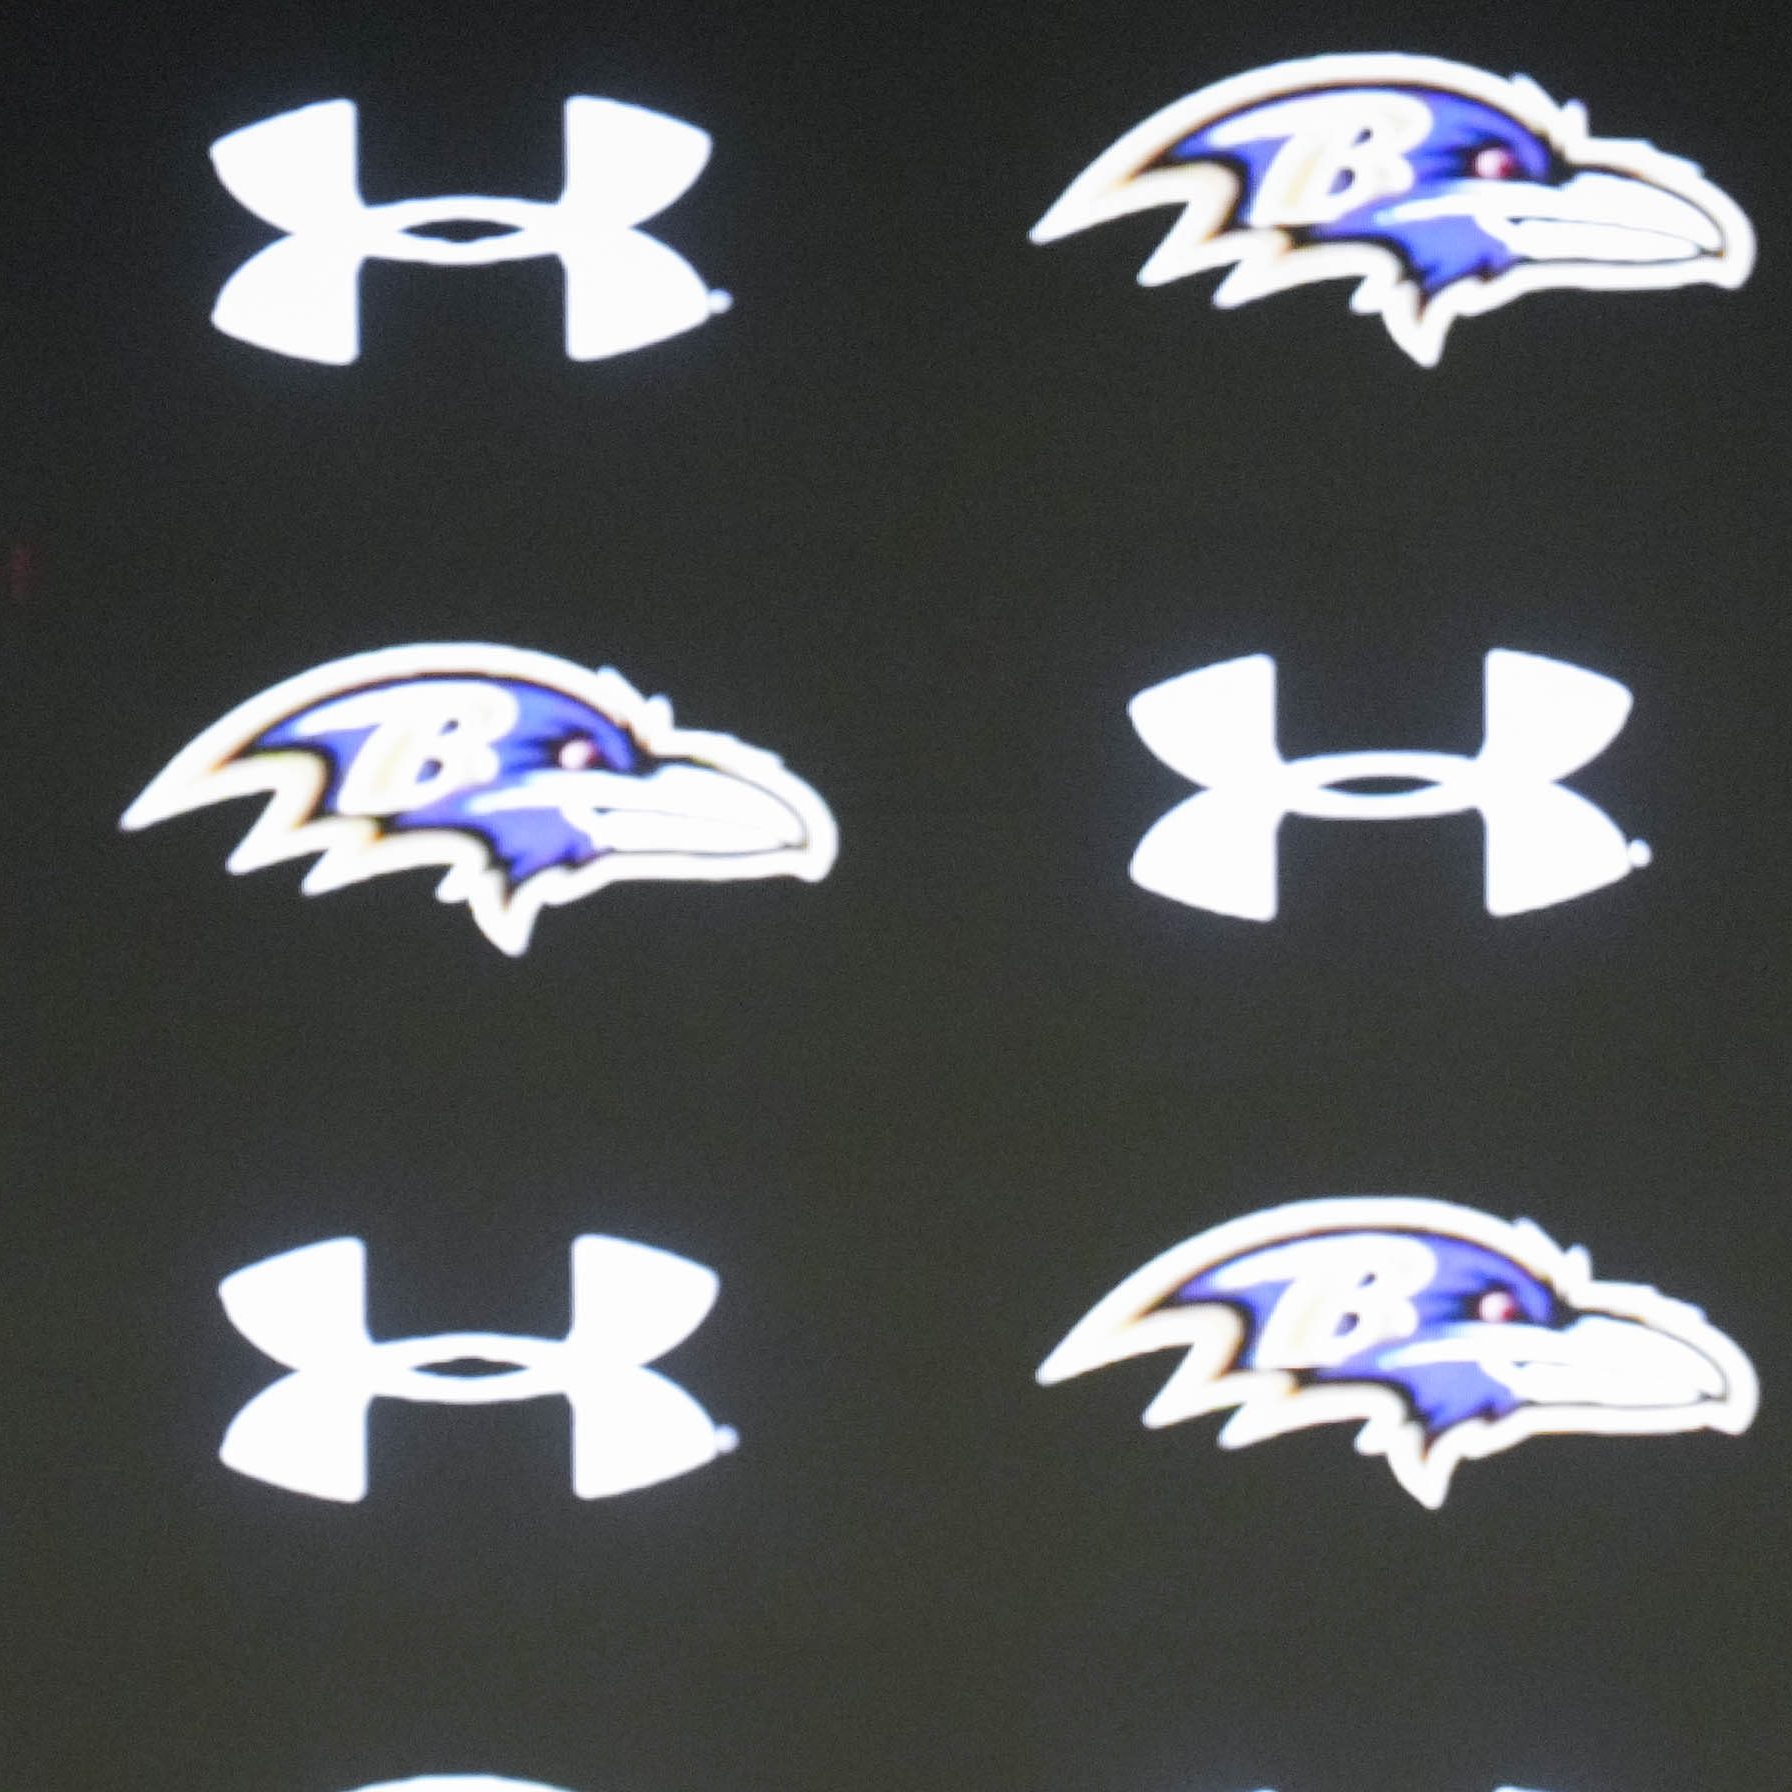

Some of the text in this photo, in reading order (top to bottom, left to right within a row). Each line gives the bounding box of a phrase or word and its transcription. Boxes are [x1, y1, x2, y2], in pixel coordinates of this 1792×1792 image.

[1206, 89, 1433, 226] B
[293, 679, 520, 816] B
[1210, 1232, 1437, 1369] B
